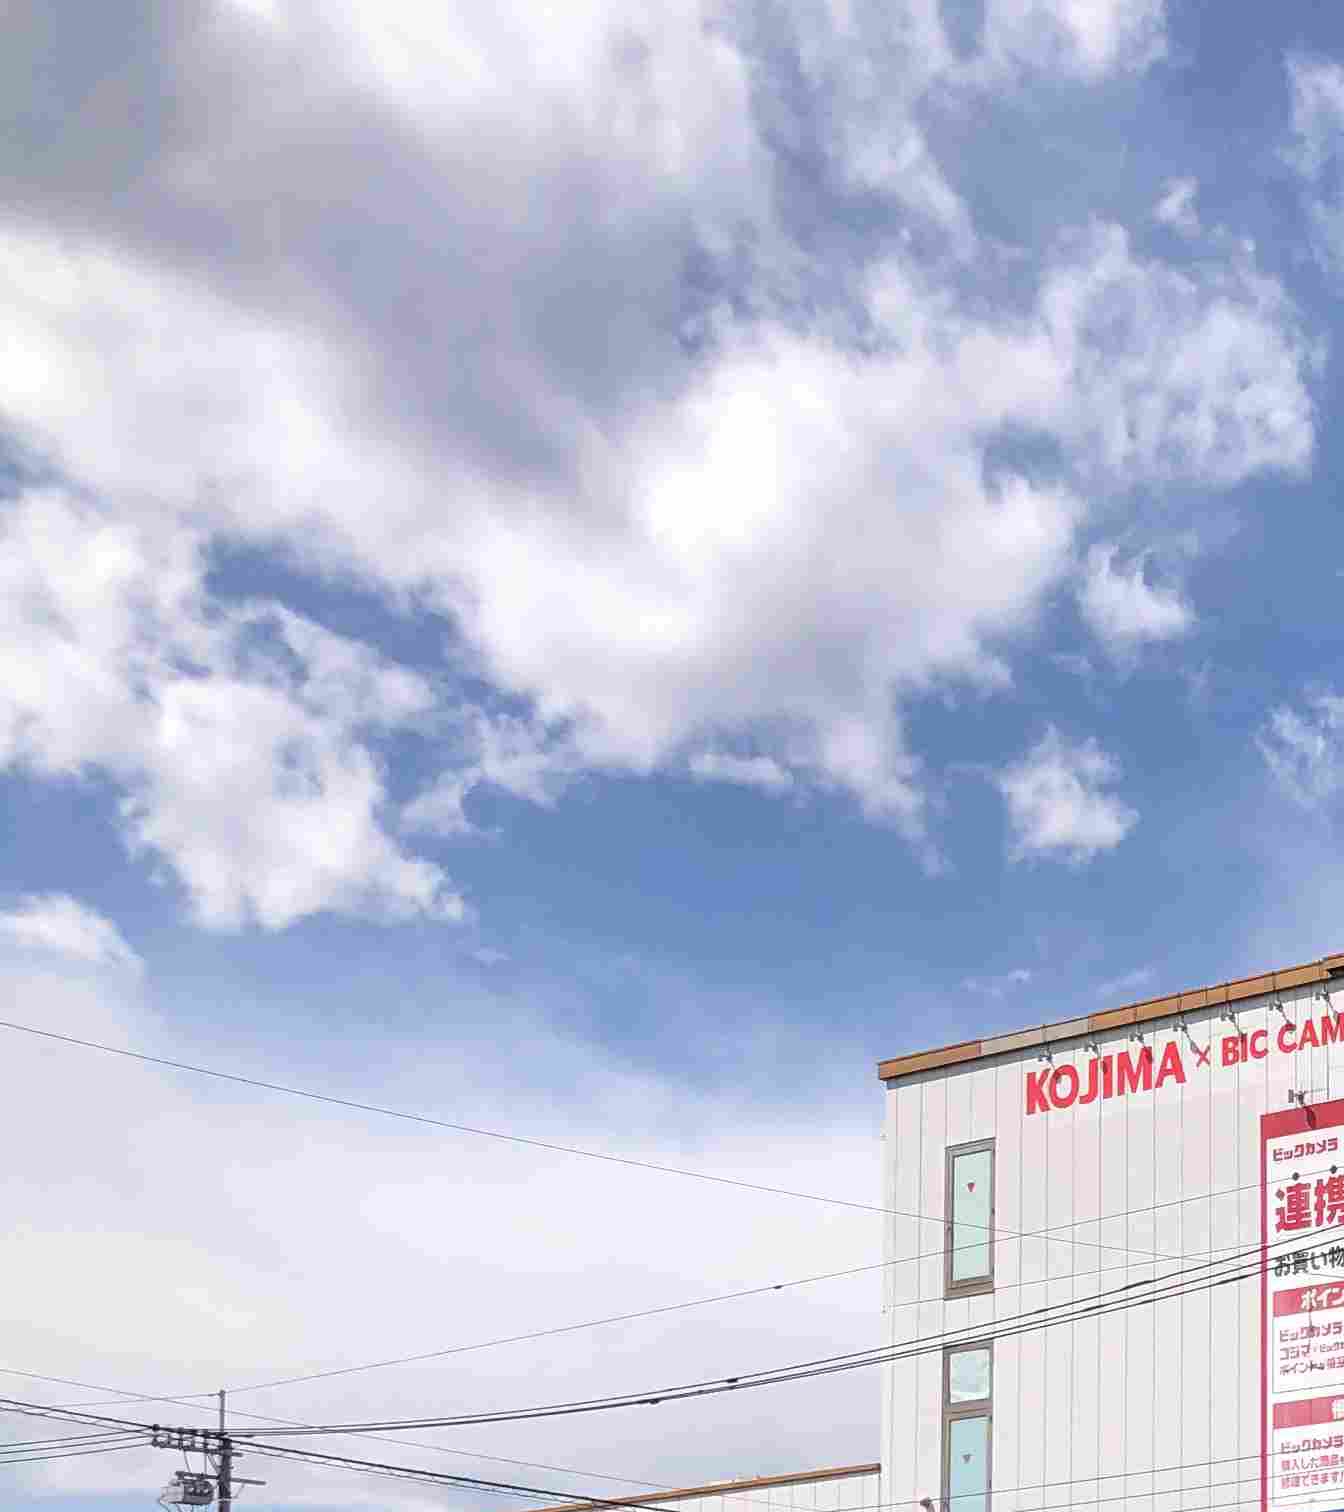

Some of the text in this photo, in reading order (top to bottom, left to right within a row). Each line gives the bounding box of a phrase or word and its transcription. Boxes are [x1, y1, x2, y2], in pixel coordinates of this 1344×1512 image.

[1025, 1040, 1187, 1116] KOJIMA
[1221, 1030, 1268, 1067] BIC
[1273, 1137, 1338, 1162] ビックカメラ
